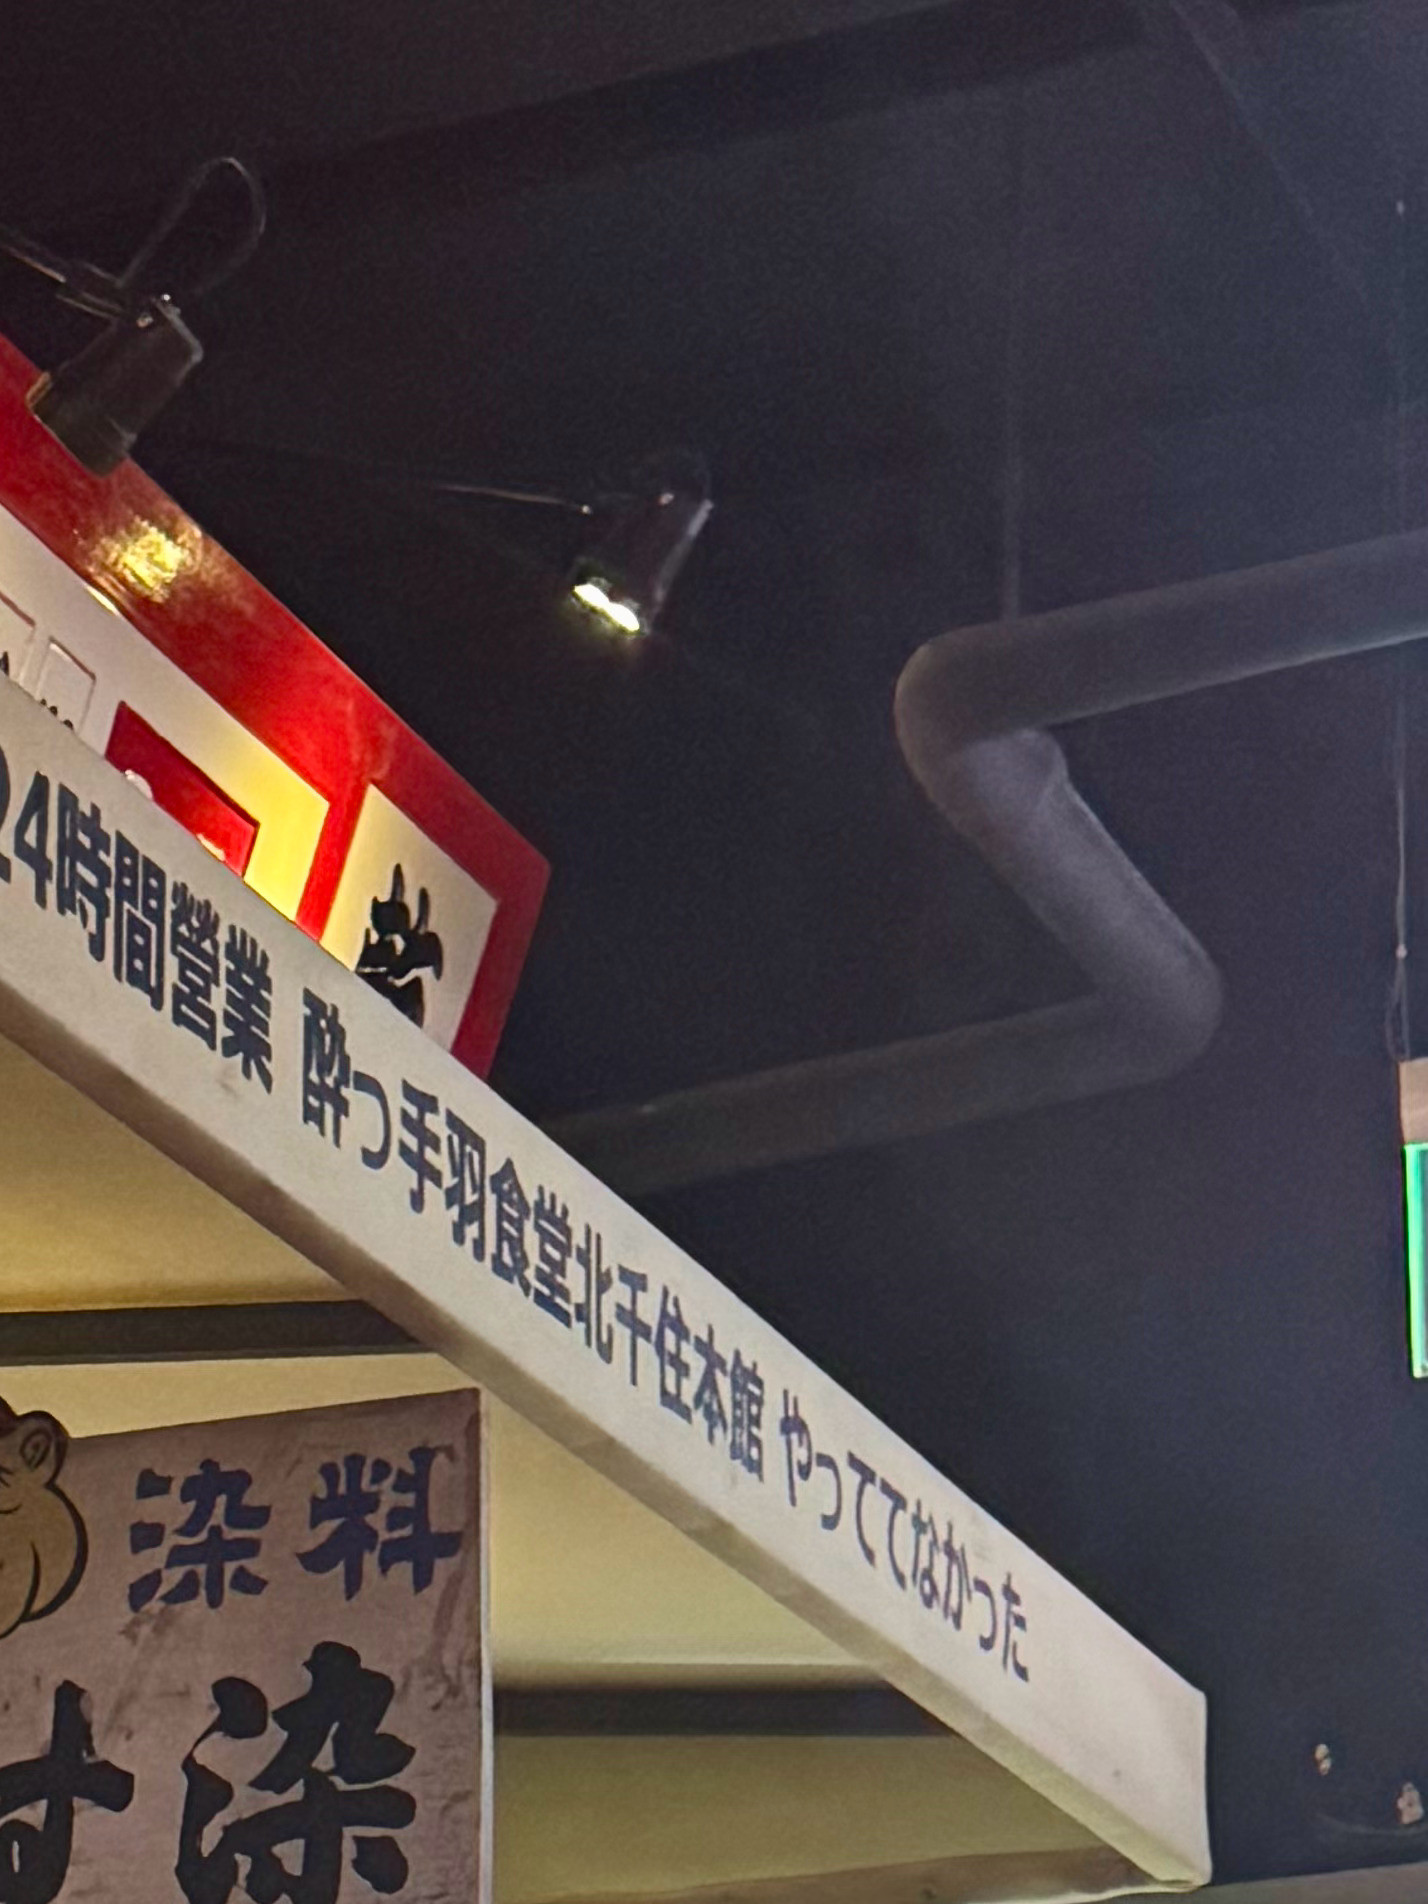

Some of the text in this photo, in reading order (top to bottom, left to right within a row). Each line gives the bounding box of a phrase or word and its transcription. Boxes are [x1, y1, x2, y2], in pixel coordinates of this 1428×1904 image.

[128, 1443, 465, 1612] 染料
[302, 988, 765, 1483] 酔っ手羽食堂北千住本館
[780, 1390, 1030, 1683] やっててなかった
